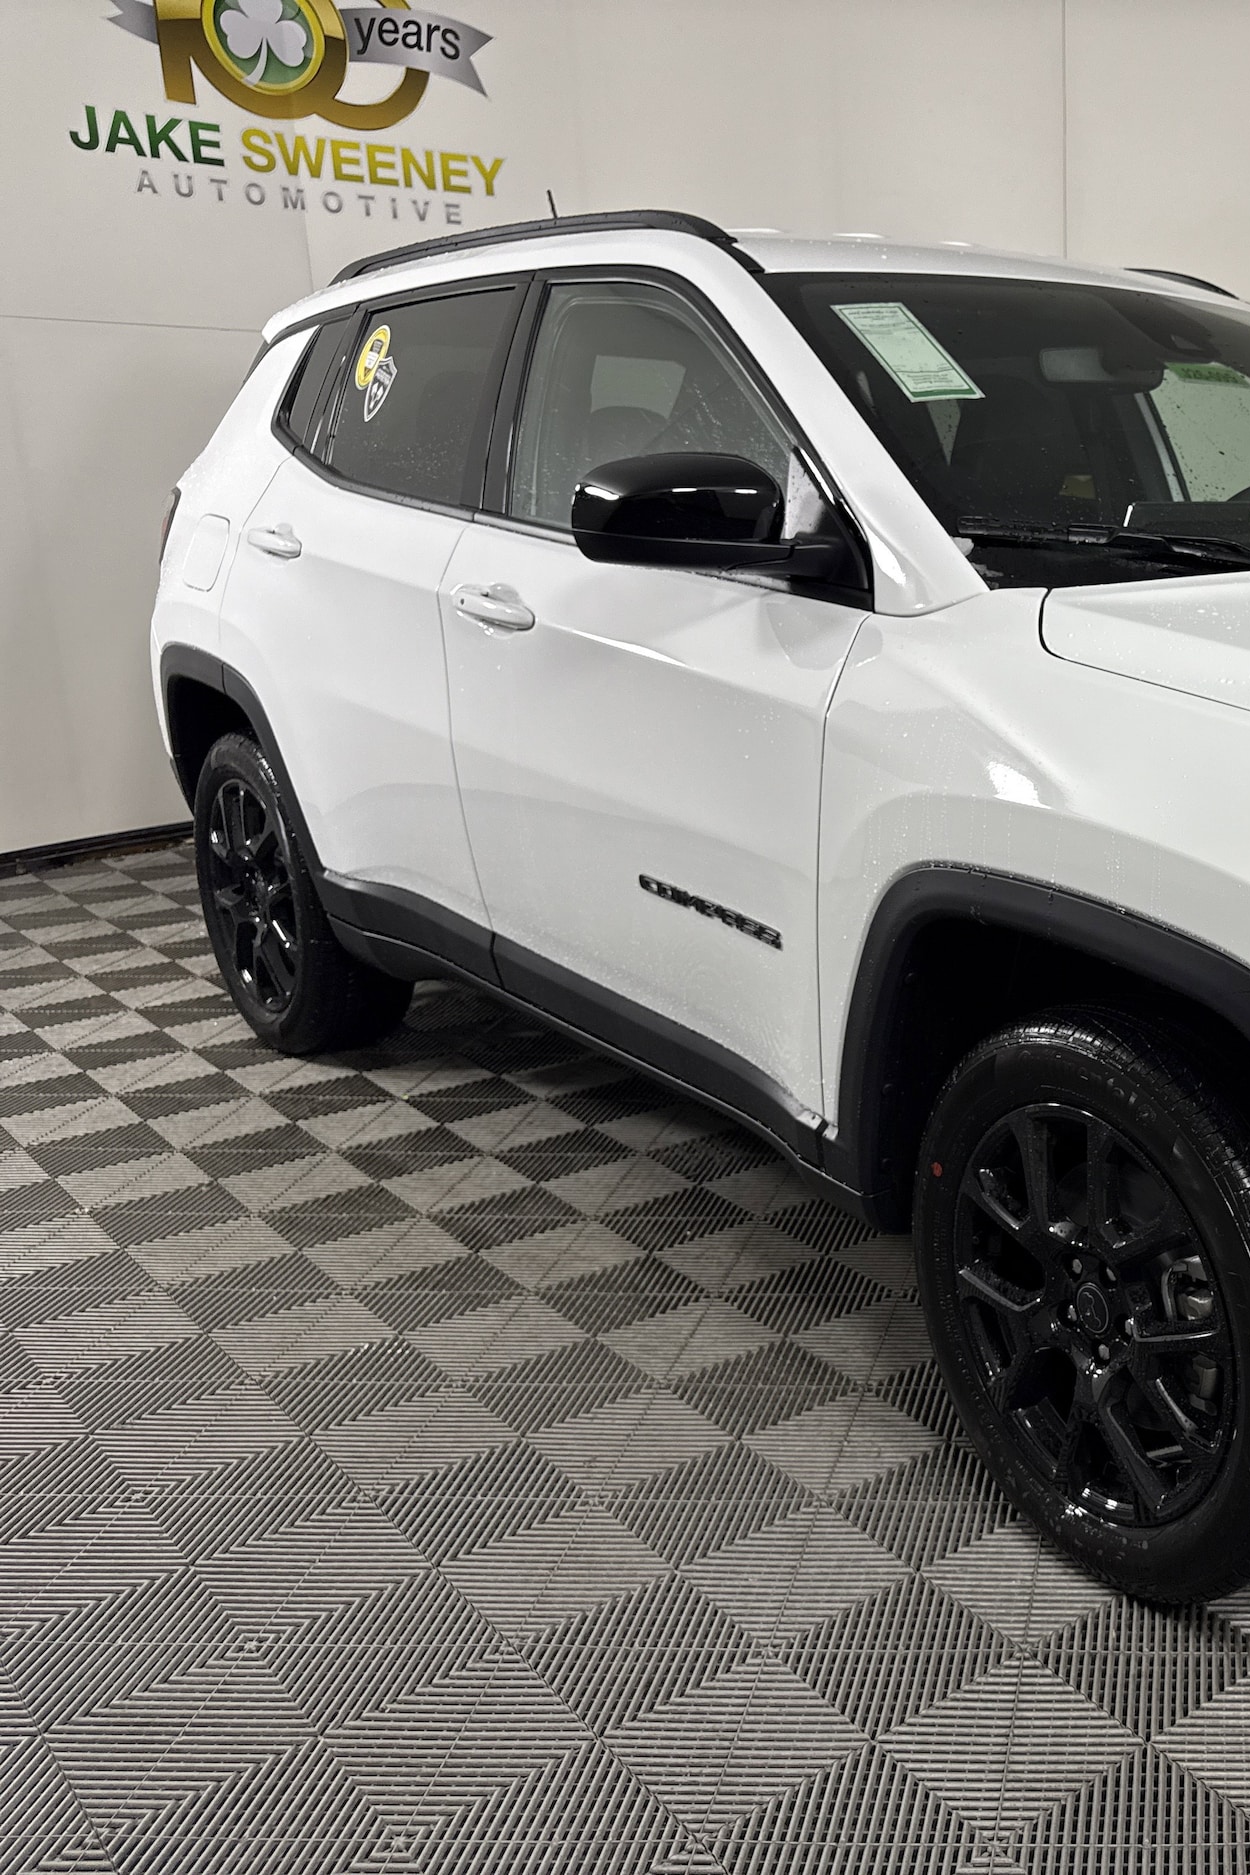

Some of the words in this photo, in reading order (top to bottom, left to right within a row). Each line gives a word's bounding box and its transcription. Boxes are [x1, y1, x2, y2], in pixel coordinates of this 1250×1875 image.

[354, 15, 461, 60] years
[69, 105, 225, 166] JAKE
[241, 128, 505, 196] SWEENEY
[136, 170, 463, 226] AUTOMOTIVE
[638, 873, 784, 952] COMPASS
